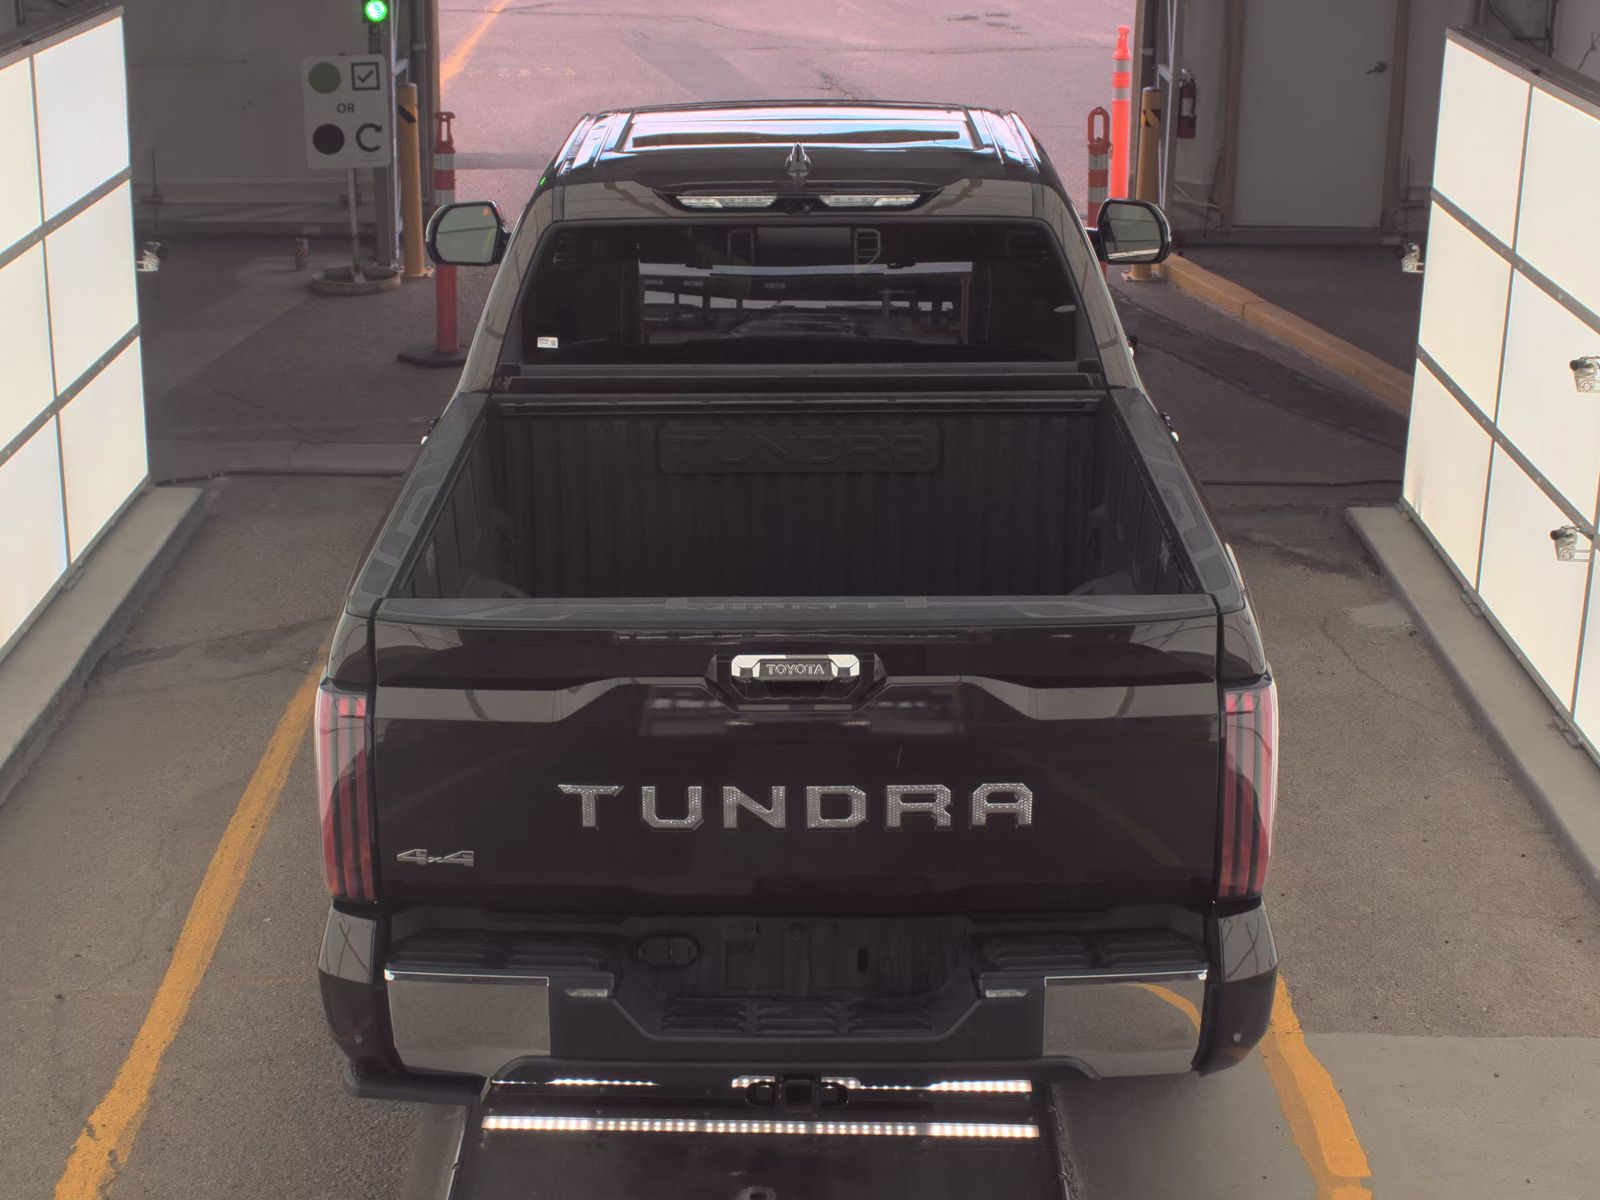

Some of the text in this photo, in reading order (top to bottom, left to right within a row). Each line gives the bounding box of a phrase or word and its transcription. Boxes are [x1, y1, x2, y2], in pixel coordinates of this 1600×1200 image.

[336, 102, 356, 114] OR
[765, 663, 825, 676] TOYOTA
[557, 782, 1034, 832] TUNDRA
